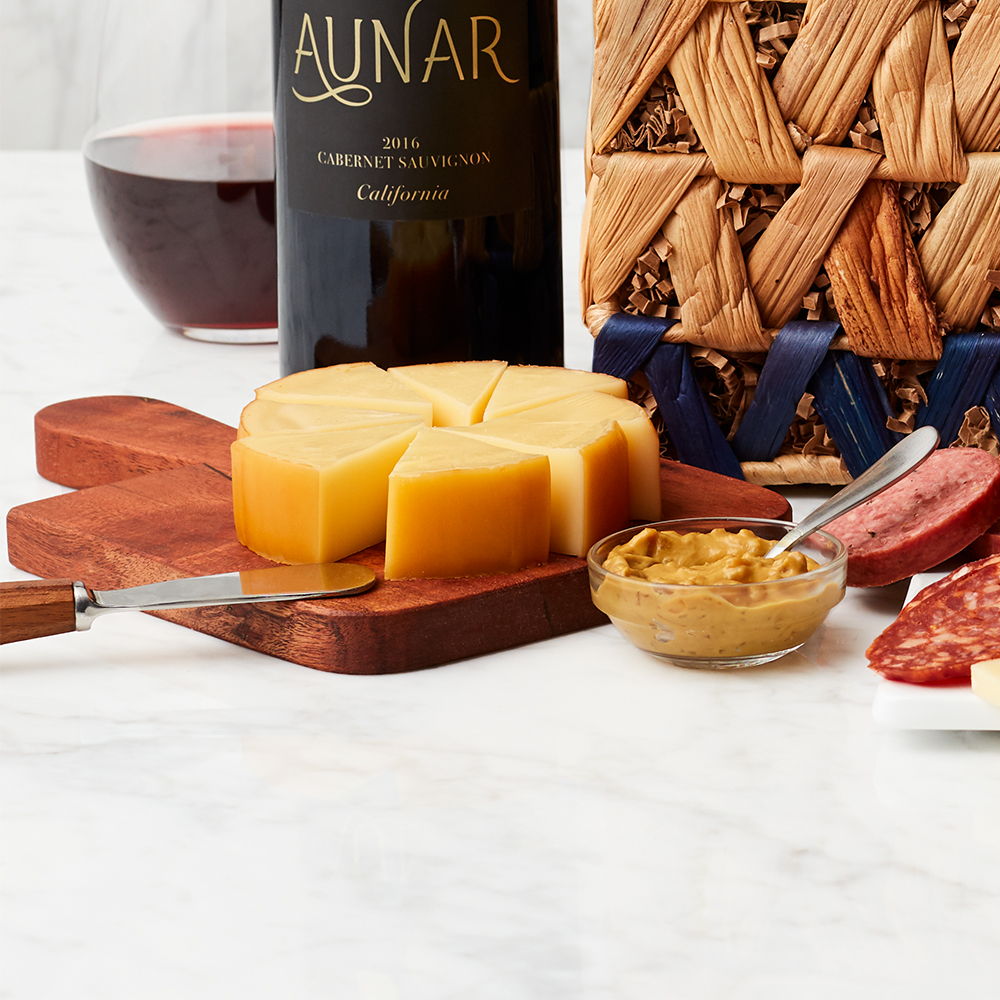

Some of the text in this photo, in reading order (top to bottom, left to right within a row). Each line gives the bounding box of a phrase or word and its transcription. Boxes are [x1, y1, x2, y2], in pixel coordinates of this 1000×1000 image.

[382, 136, 420, 150] 2016
[317, 151, 491, 169] CABERNET SAUVIGNON
[356, 183, 450, 207] California
